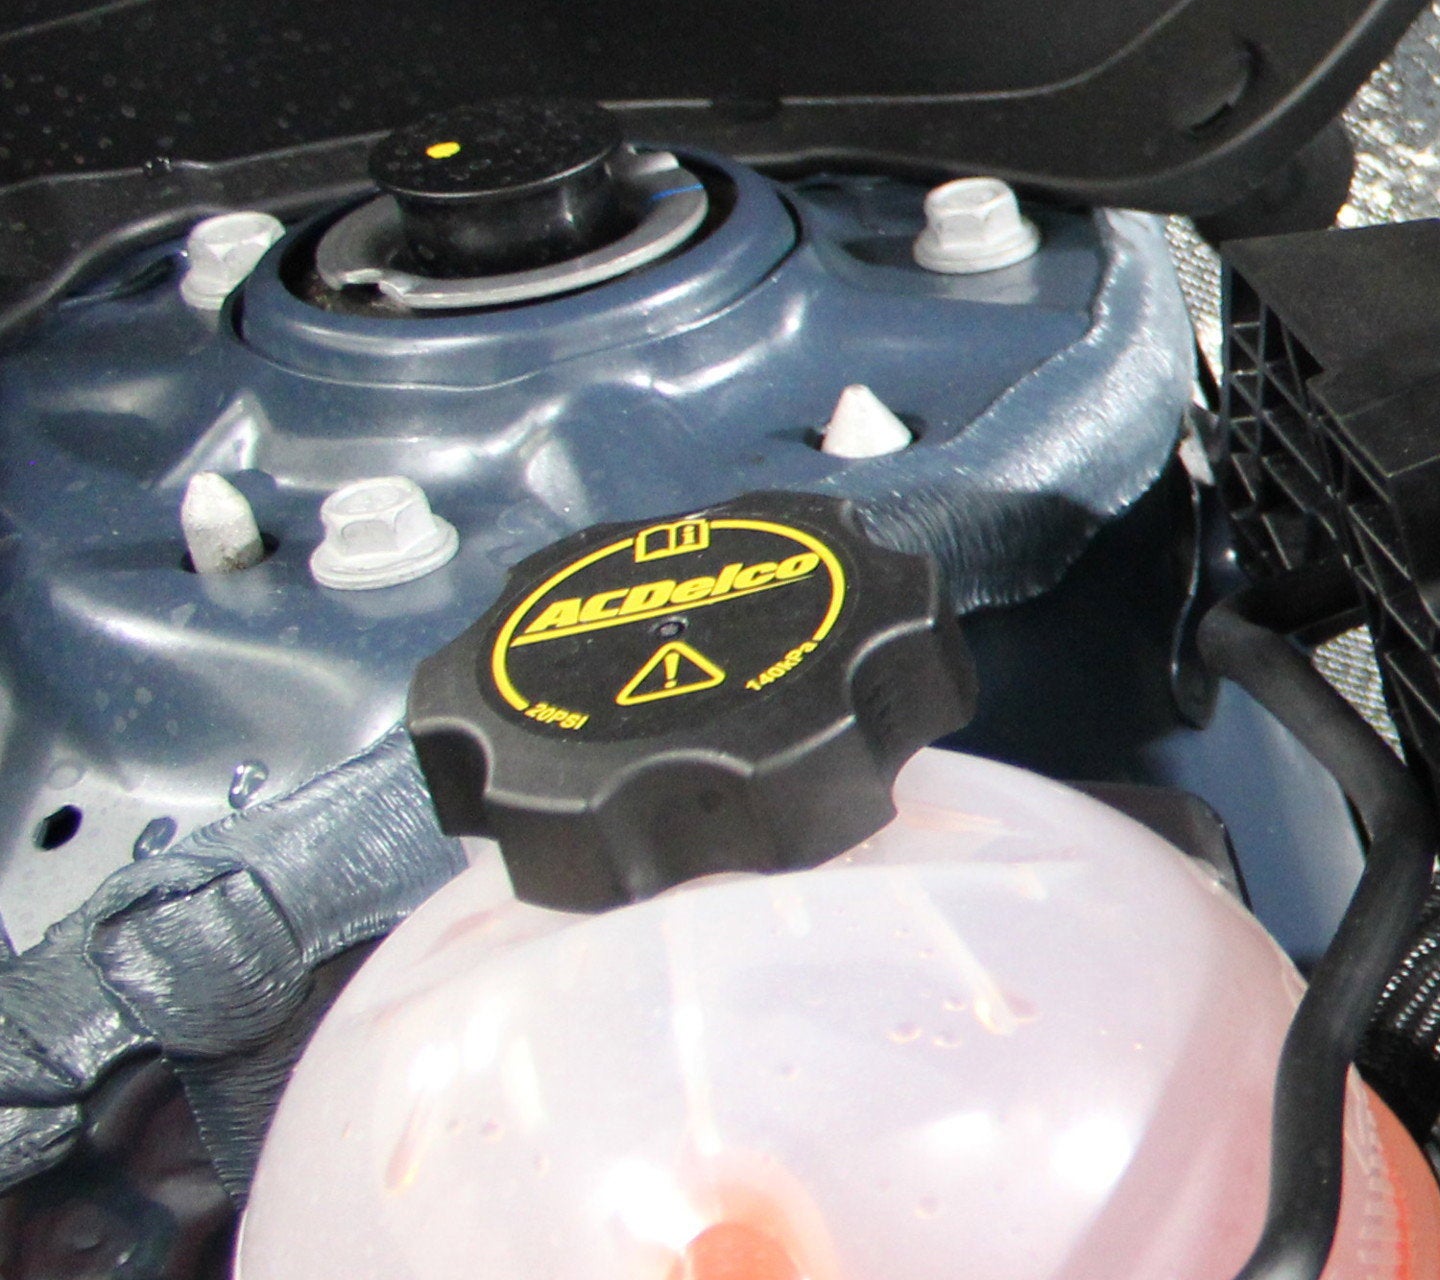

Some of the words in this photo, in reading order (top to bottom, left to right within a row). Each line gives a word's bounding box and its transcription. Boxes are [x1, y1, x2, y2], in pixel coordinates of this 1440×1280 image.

[522, 551, 820, 635] ACDelco
[744, 639, 819, 694] 140kPa
[522, 701, 590, 731] 20PSI
